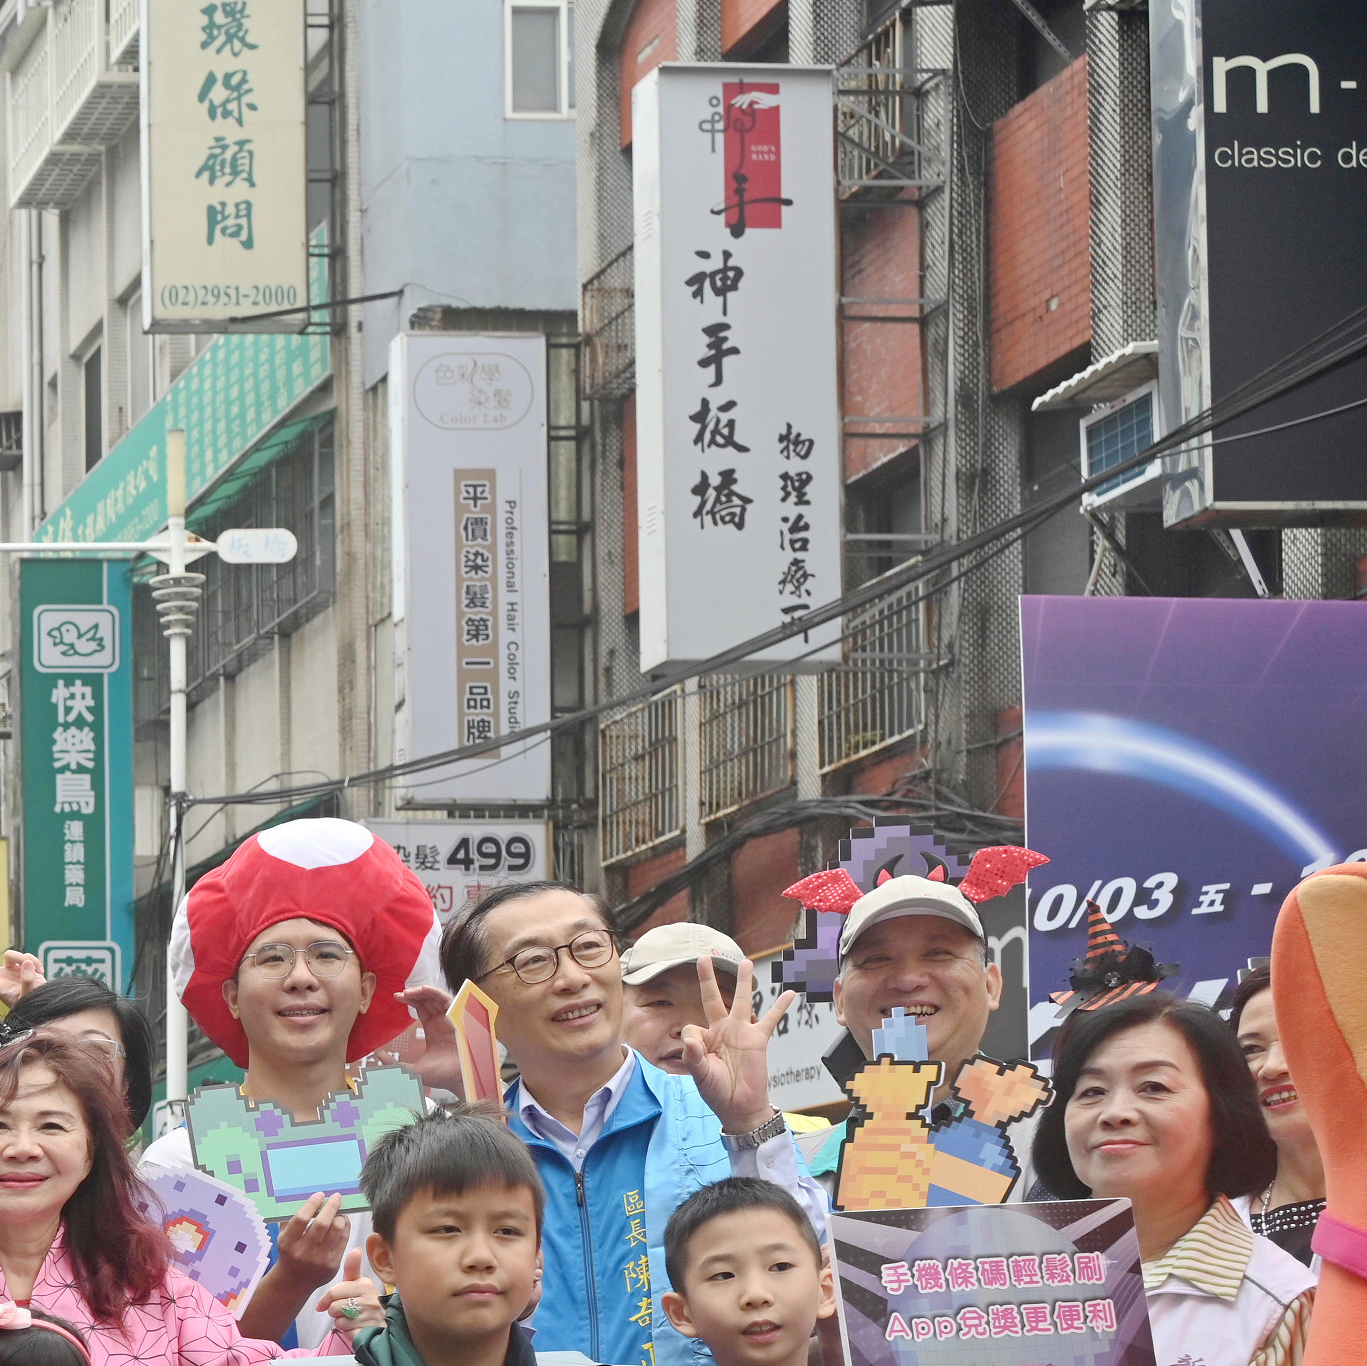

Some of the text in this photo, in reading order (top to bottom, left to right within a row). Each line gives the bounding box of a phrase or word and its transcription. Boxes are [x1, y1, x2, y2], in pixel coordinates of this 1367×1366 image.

[1213, 139, 1323, 169] classic
[160, 283, 298, 310] (02)2951-2000
[684, 249, 754, 532] 神手板橋
[504, 499, 519, 594] Professional
[462, 483, 492, 744] 平價染髮第一品牌
[506, 601, 520, 633] Hair
[506, 641, 520, 682] Color
[50, 679, 96, 816] 快樂鳥
[446, 836, 531, 872] 499
[879, 1251, 1108, 1296] 手機條碼輕鬆刷
[883, 1299, 1117, 1342] App兌獎更便利
